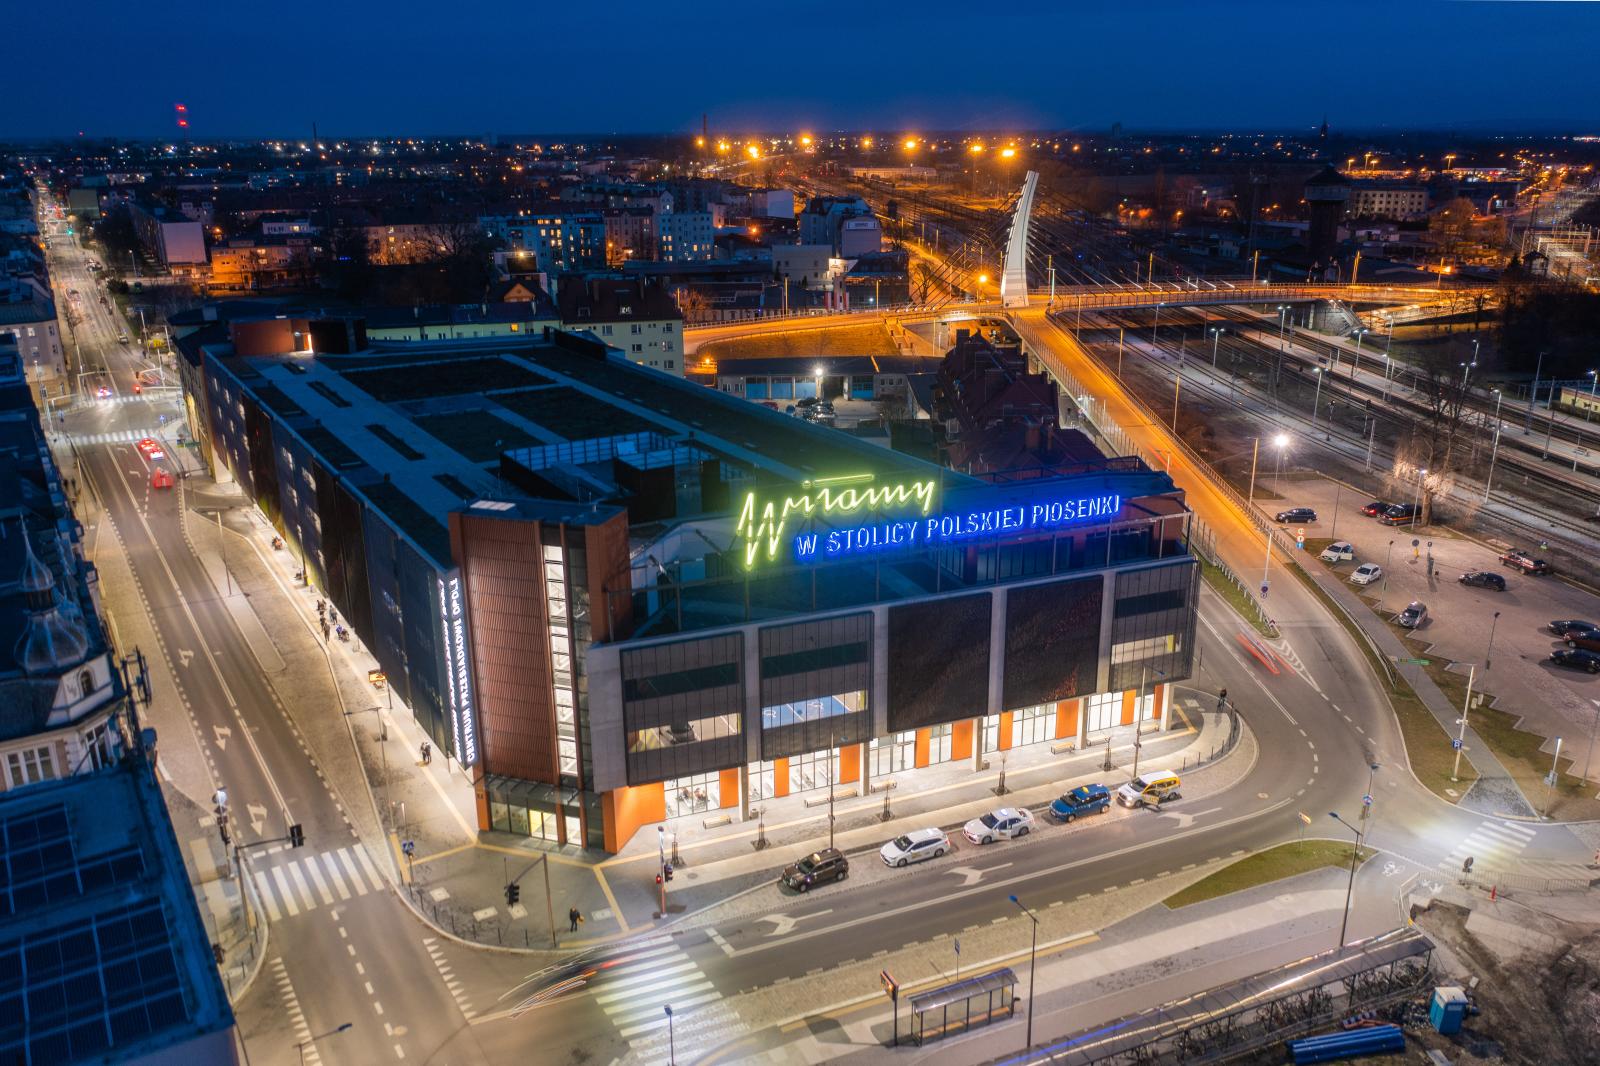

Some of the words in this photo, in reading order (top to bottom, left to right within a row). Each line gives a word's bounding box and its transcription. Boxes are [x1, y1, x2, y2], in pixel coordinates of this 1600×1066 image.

[737, 473, 935, 567] Witamy
[797, 533, 818, 556] W
[826, 520, 919, 553] STOLICY
[926, 507, 1025, 538] POLSKIEJ
[1032, 494, 1121, 525] PIOSENKI
[450, 577, 461, 615] OPOLE
[453, 617, 469, 707] PRZESIADKOWE
[462, 707, 475, 762] CENTRUM
